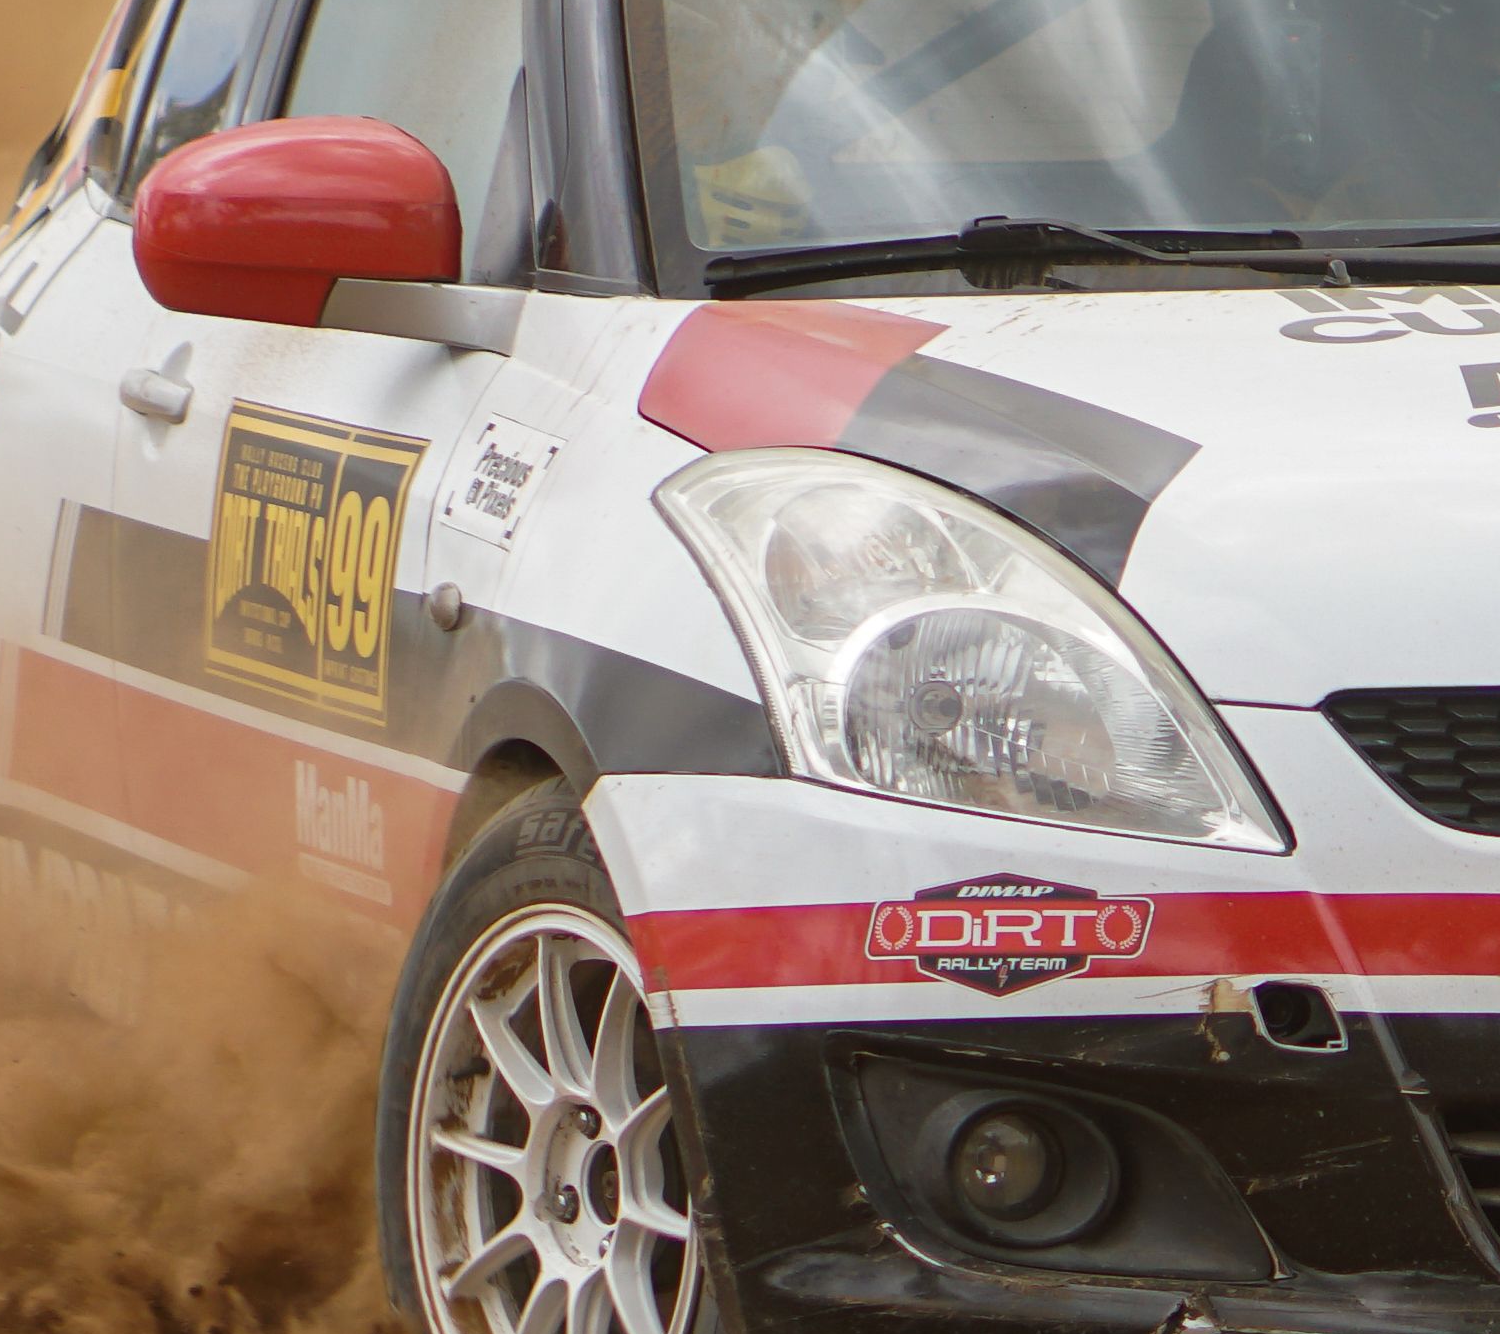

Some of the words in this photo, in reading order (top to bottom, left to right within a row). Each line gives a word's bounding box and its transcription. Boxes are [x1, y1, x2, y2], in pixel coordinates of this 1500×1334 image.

[326, 490, 392, 659] 99
[955, 884, 1055, 898] DIMAP
[937, 957, 1001, 971] RALLY
[1008, 957, 1068, 971] TEAM
